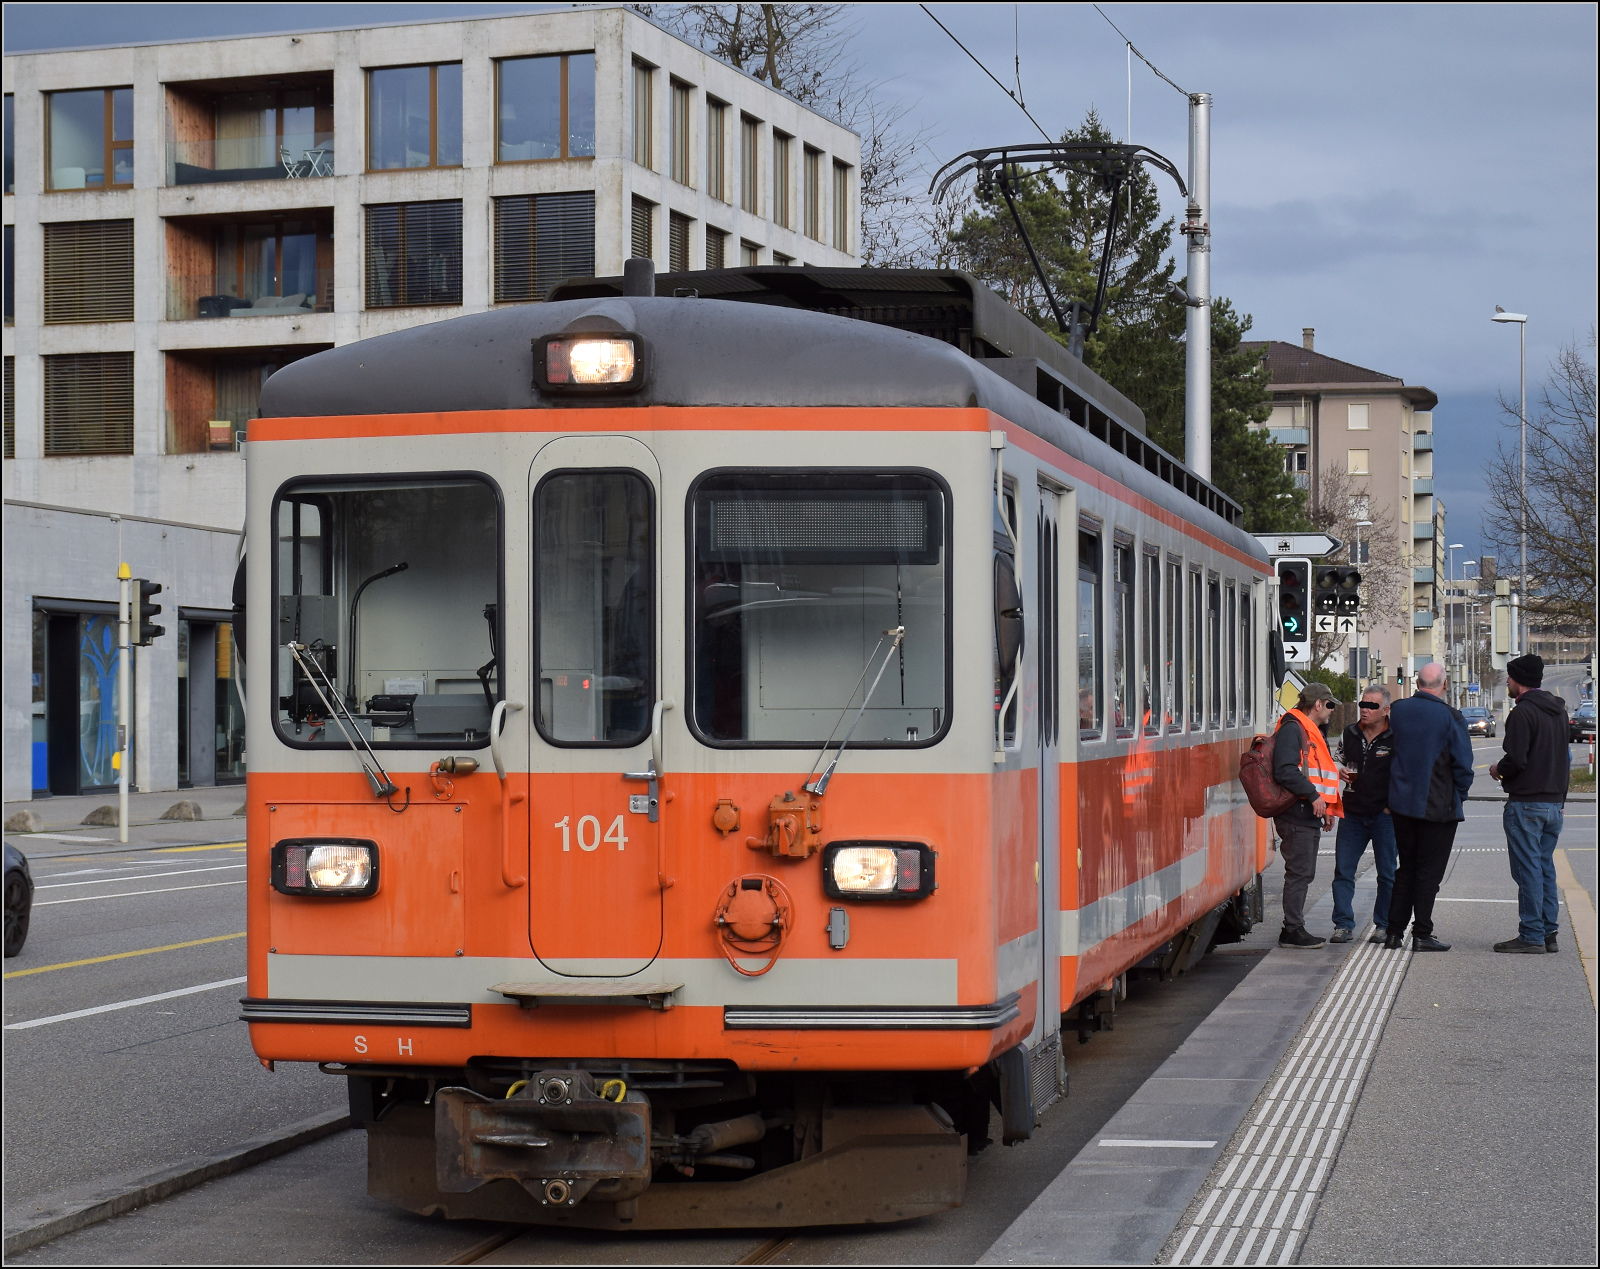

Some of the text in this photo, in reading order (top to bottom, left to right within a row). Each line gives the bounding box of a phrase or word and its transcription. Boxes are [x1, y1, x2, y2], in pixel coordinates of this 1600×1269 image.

[554, 814, 629, 852] 104
[354, 1035, 413, 1056] S H
